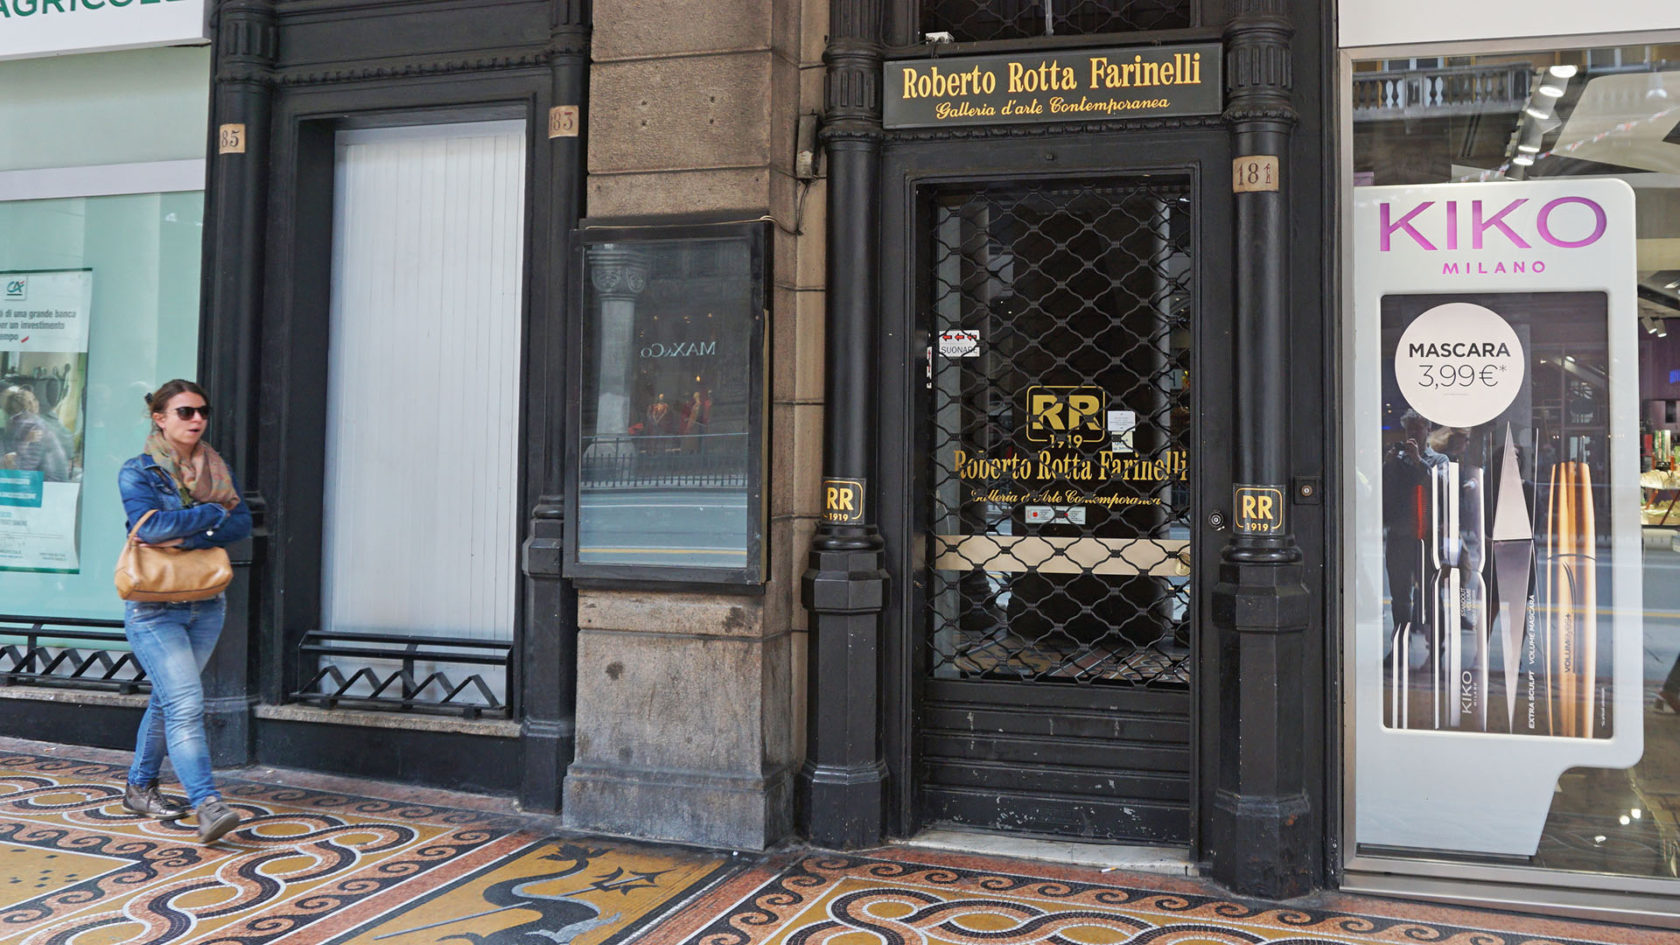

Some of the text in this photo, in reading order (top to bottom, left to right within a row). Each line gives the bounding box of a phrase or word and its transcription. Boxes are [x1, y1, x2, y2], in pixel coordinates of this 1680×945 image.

[902, 52, 1202, 99] Roberto Rotta Farinelli
[935, 95, 1171, 120] Galleria d'arte Contemporanea
[221, 130, 240, 147] 85
[1237, 163, 1271, 185] 181
[1379, 196, 1607, 252] KIKO
[1442, 261, 1546, 275] MILANO
[1408, 342, 1511, 358] MASCARA
[1032, 394, 1102, 430] RR
[1036, 450, 1093, 480] Rotta
[826, 487, 854, 510] RR
[1242, 495, 1273, 519] RR
[828, 512, 849, 521] 1919
[1246, 522, 1269, 531] 1919
[1462, 670, 1473, 714] KIKO
